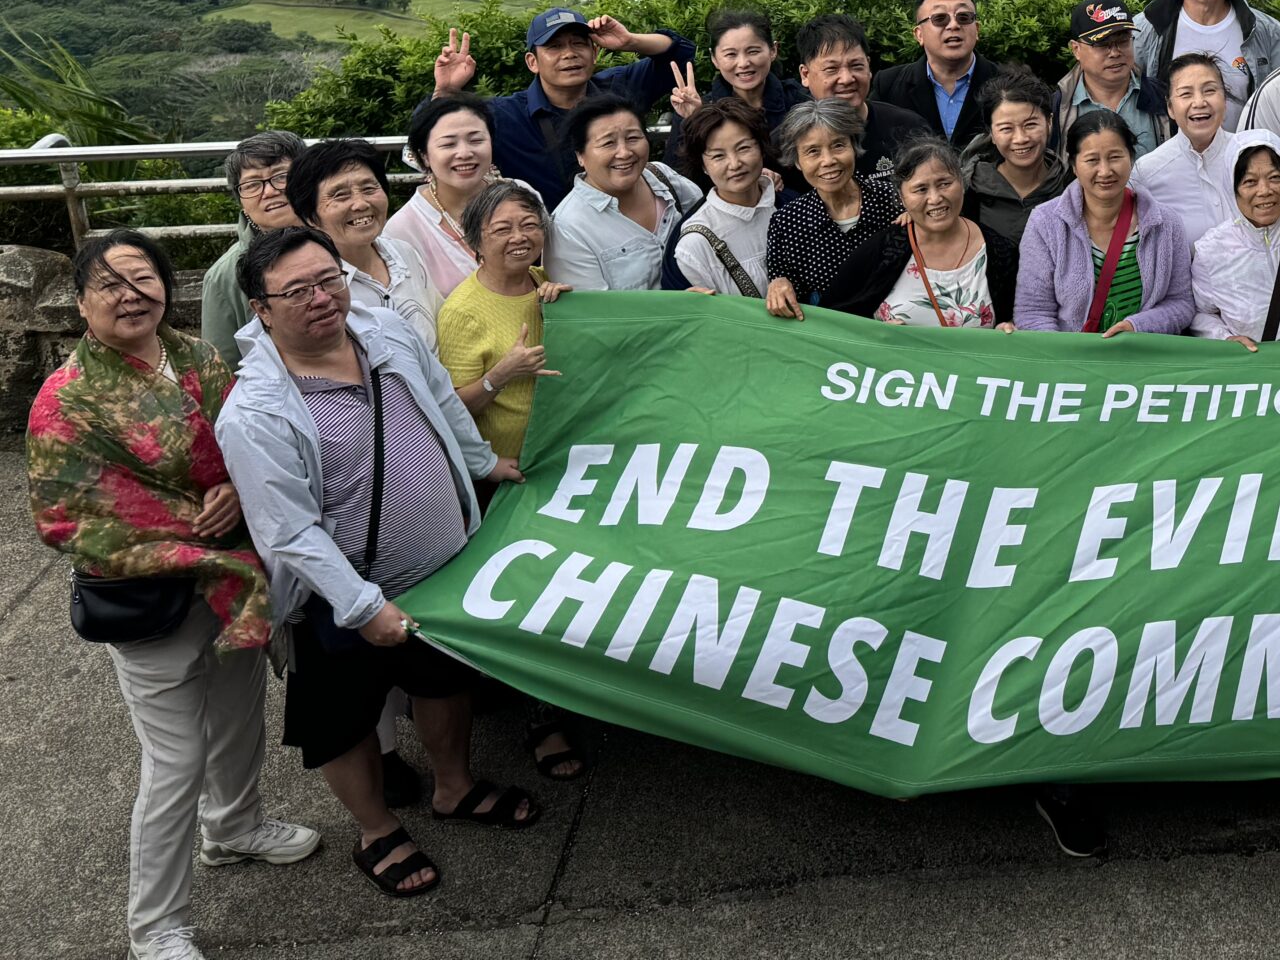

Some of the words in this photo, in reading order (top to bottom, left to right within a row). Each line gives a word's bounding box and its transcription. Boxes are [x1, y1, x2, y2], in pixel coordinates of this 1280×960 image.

[820, 361, 959, 409] SIGN
[976, 376, 1087, 423] THE
[537, 442, 771, 532] END
[816, 460, 1039, 589] THE
[462, 539, 948, 747] CHINESE
